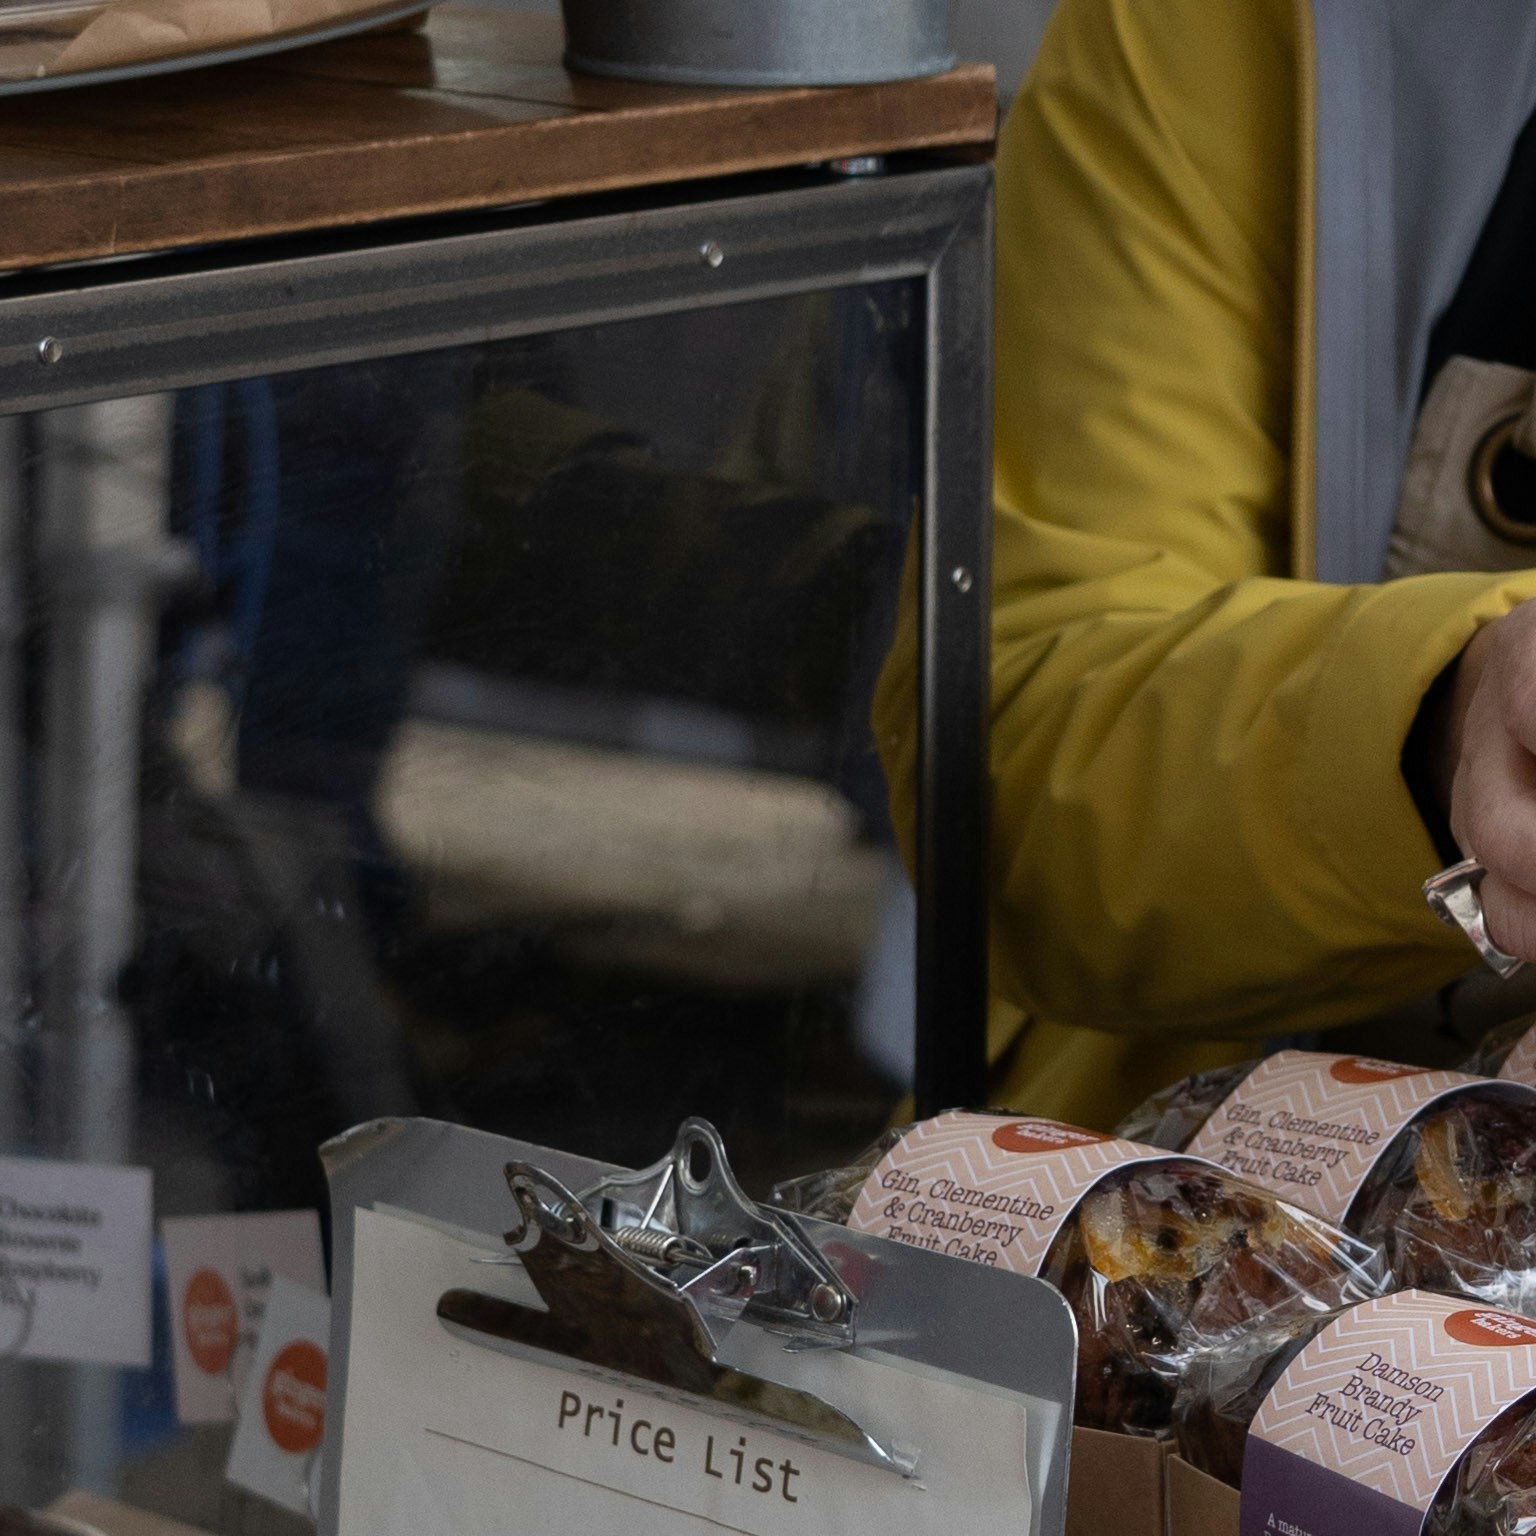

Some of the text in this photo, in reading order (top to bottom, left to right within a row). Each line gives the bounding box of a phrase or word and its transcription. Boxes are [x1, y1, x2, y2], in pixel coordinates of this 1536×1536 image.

[1222, 1126, 1350, 1168] & Cranberry
[1268, 1110, 1381, 1145] Clementine
[881, 1168, 1055, 1221] Gin, Clementine
[1219, 1150, 1323, 1187] Fruit Cake
[883, 1195, 1024, 1248] & Cranberry
[1338, 1374, 1423, 1426] Brandy
[1355, 1352, 1445, 1403] Damson
[557, 1390, 802, 1503] Price List
[1305, 1392, 1416, 1457] Fruit Cake
